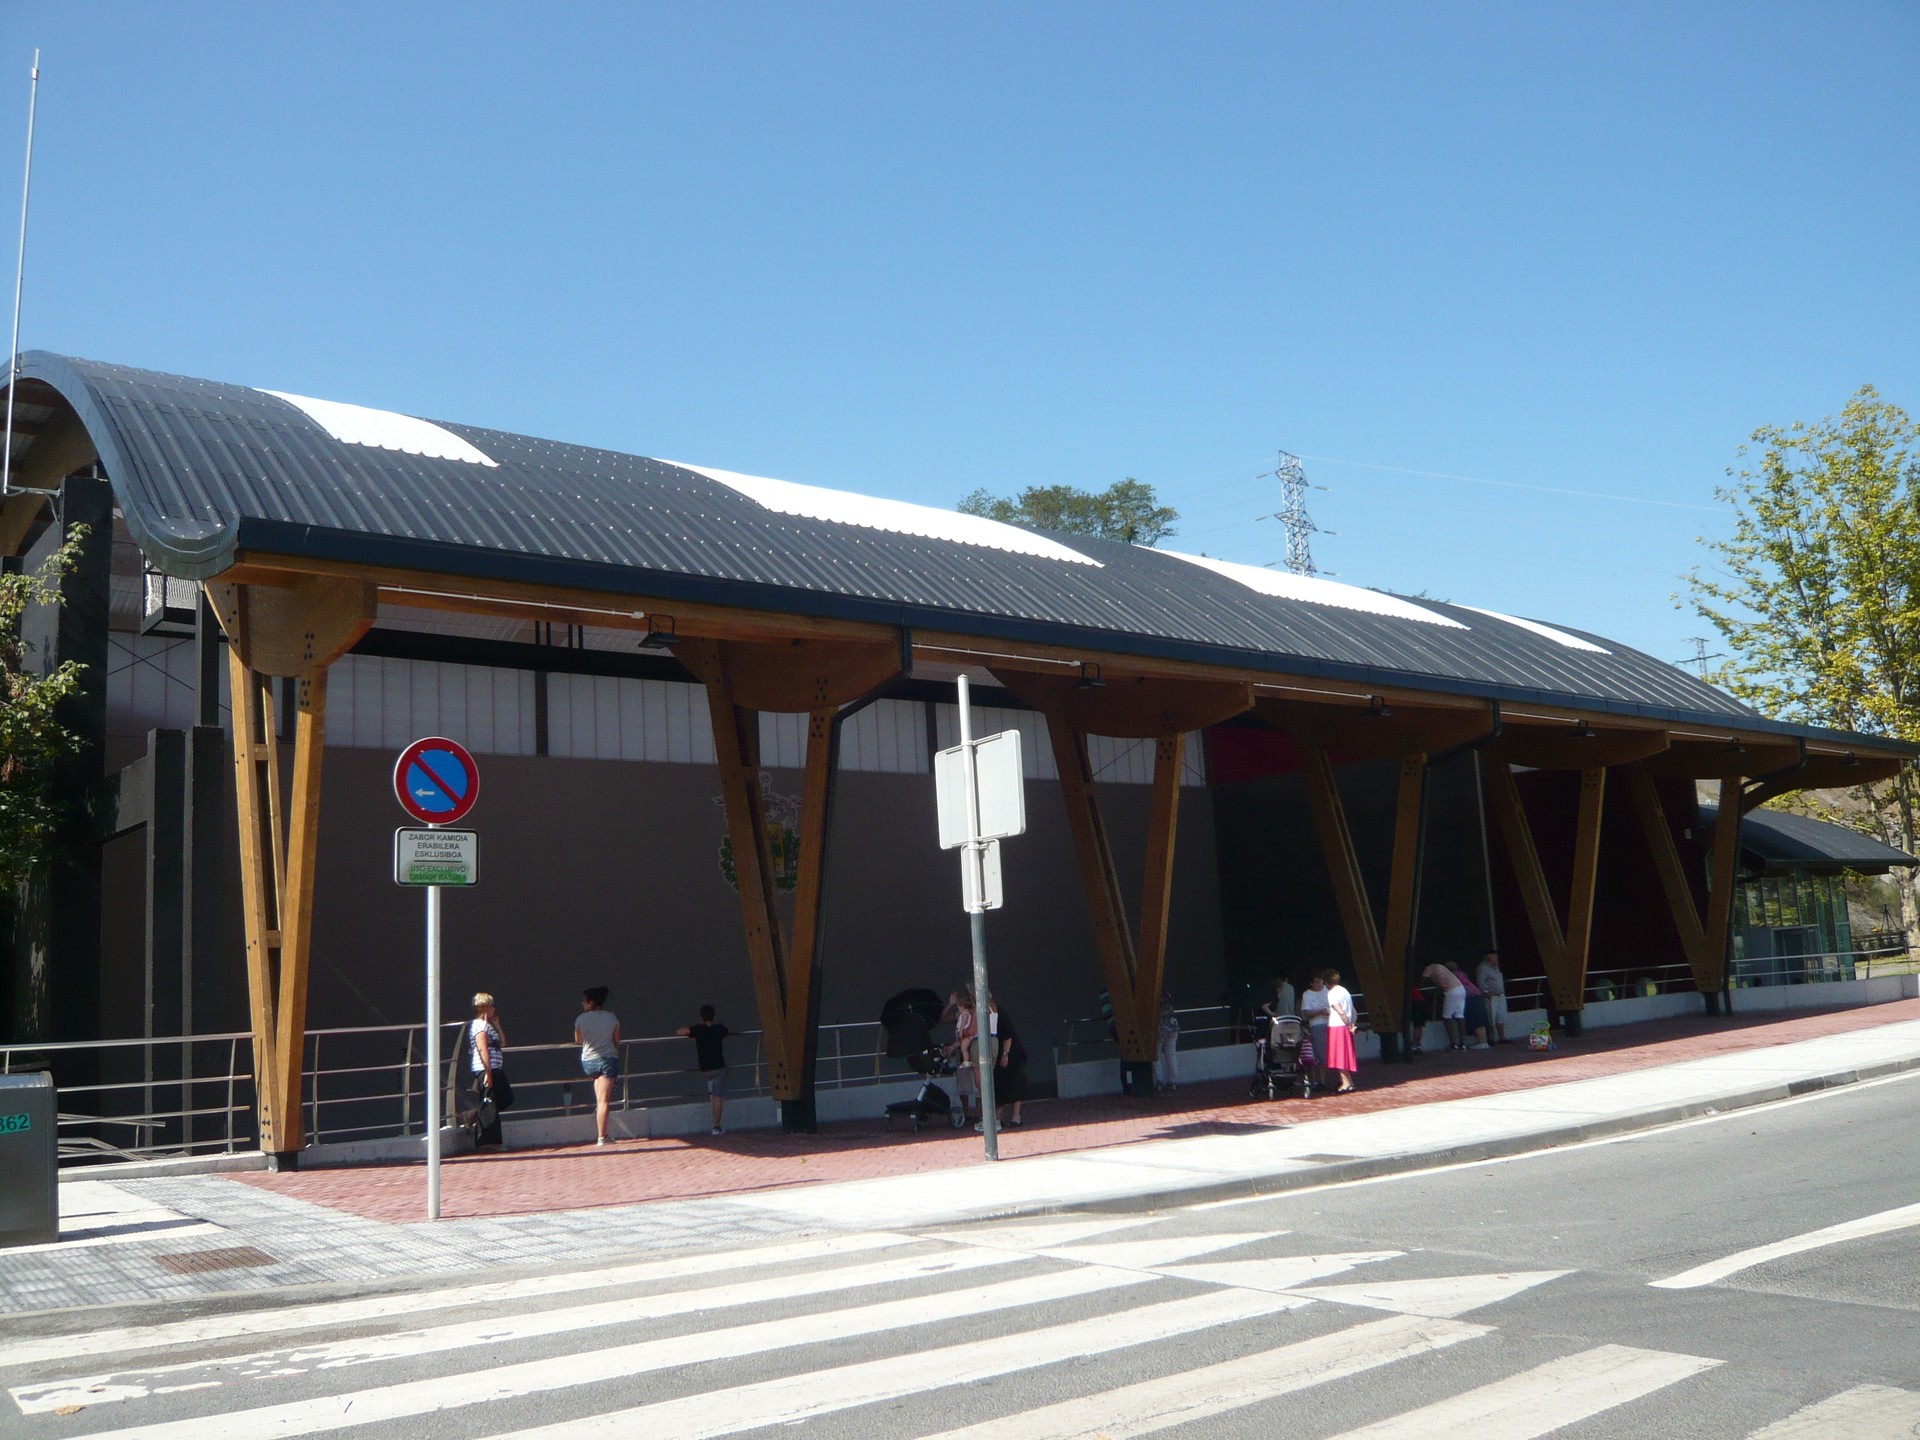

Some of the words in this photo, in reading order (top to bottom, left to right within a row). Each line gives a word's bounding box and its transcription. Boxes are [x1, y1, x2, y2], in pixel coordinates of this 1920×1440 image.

[408, 833, 435, 841] ZABOR
[417, 842, 460, 850] ERABILERA
[414, 850, 463, 858] ESKLUSIBOA
[427, 865, 466, 873] EXCLUSIVO
